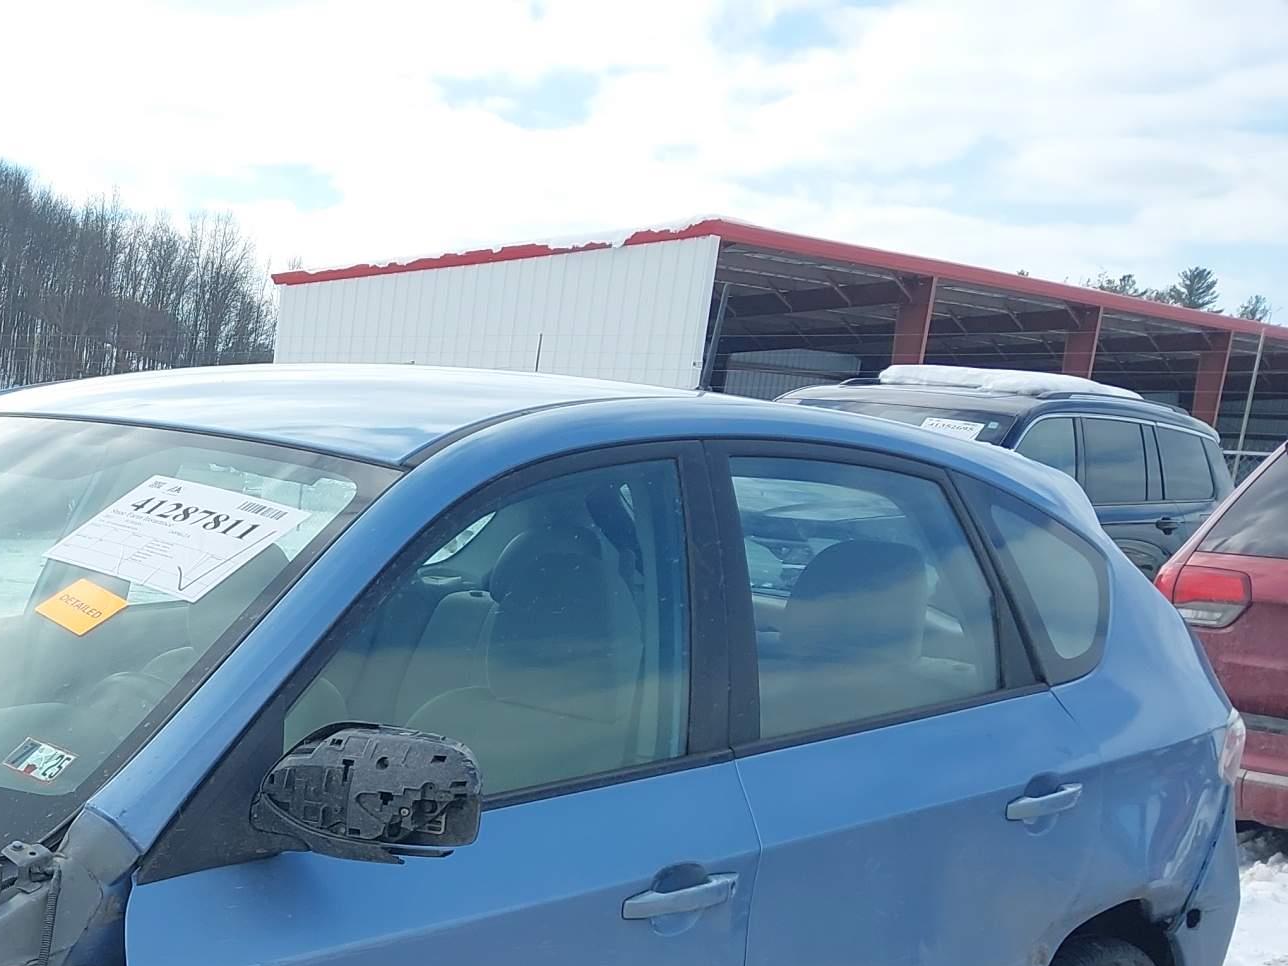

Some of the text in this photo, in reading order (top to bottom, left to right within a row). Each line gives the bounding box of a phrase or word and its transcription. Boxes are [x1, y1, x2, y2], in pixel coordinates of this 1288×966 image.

[130, 496, 261, 540] 41287811
[59, 593, 103, 619] DETAILED
[41, 754, 72, 779] 25
